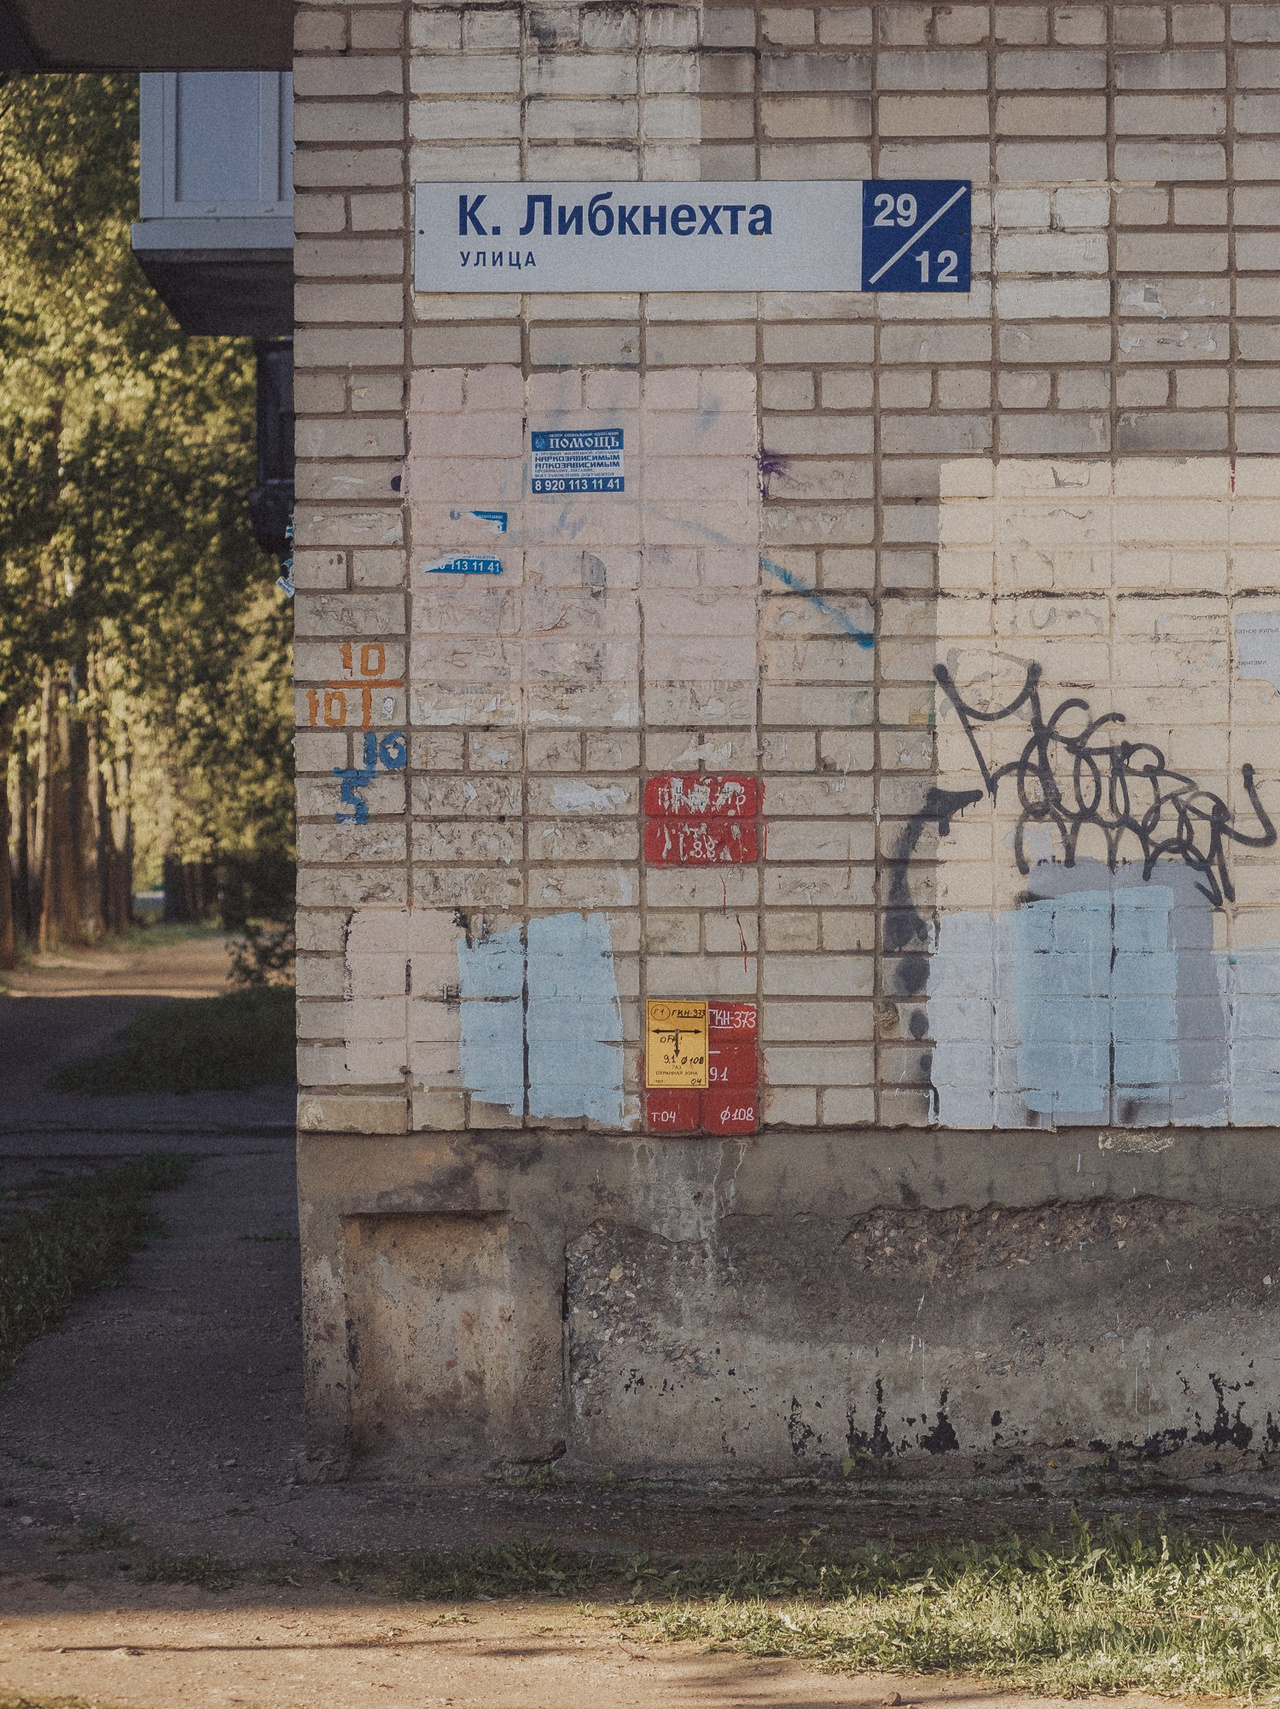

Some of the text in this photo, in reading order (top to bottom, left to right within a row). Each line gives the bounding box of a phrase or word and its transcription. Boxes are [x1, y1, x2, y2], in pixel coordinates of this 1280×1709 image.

[458, 191, 774, 237] К. Либкнехта
[873, 193, 919, 227] 29
[459, 251, 538, 270] УЛИЦА
[914, 250, 959, 284] 12
[549, 436, 620, 449] ПОМОЩЬ
[534, 454, 621, 462] НАРКОЗАВИСИМЫМ
[534, 461, 621, 469] АЛКОЗАВИСИМЫМ
[535, 478, 620, 491] 8 920 113 11 41
[472, 561, 484, 571] 11
[488, 562, 500, 572] 41
[339, 643, 386, 677] 10
[306, 689, 347, 727] 10
